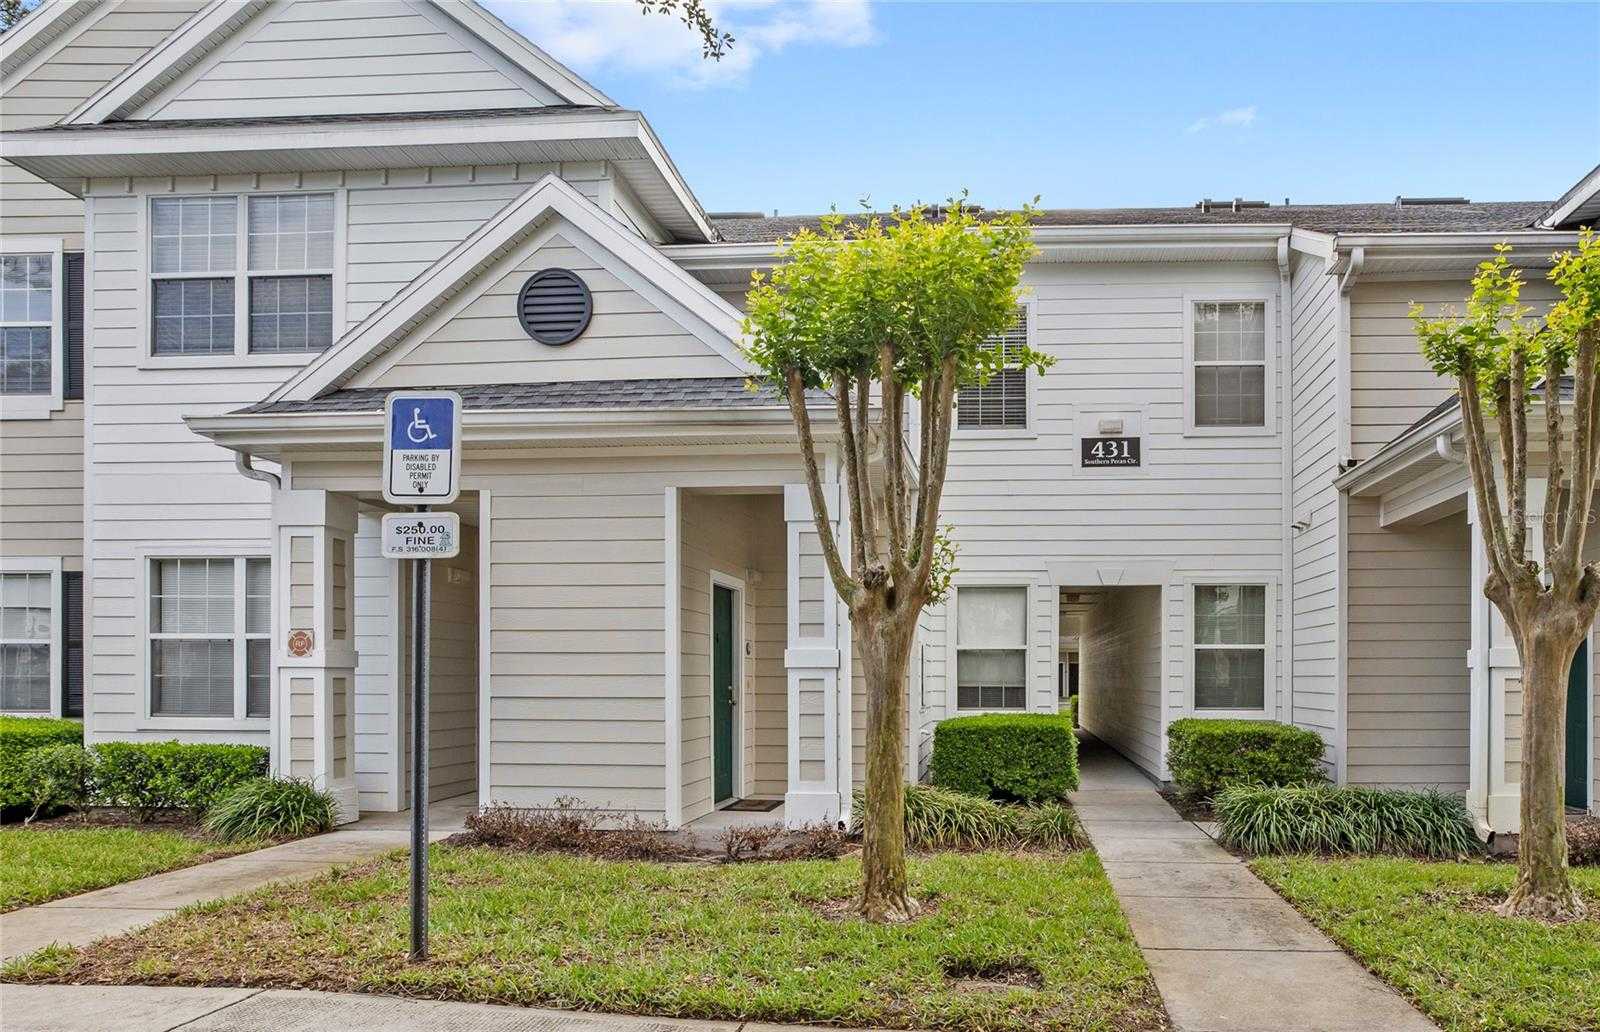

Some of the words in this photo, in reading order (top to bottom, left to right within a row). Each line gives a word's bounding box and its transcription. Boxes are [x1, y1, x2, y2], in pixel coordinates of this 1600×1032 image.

[1091, 440, 1131, 457] 431
[405, 463, 437, 471] DISABLED
[409, 472, 432, 480] PERMIT
[395, 525, 445, 535] $250.00
[405, 536, 435, 545] FINE
